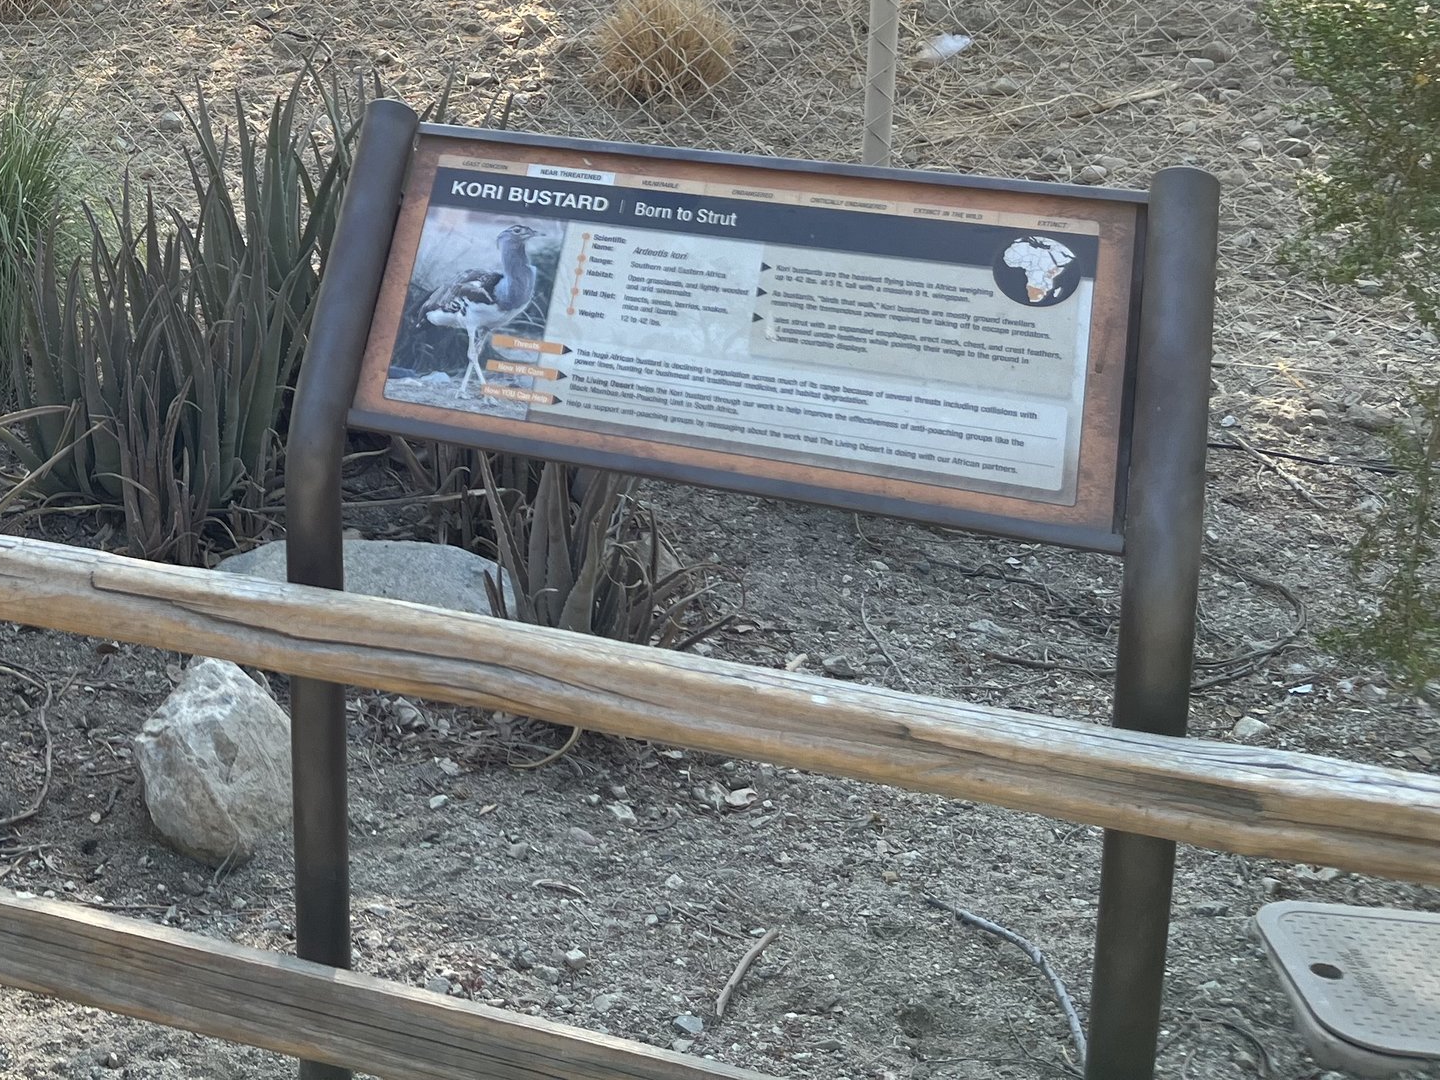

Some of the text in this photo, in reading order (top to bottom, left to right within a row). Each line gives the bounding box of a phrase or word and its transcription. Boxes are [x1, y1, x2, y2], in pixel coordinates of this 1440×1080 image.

[539, 168, 602, 180] NEAR THREATENED
[450, 180, 609, 211] KORI BUSTARD
[634, 202, 737, 226] Born to Strut
[913, 207, 940, 215] EXTINCT
[965, 212, 983, 220] WILD
[1037, 219, 1068, 228] EXTINCT
[931, 292, 970, 303] wingspan.
[934, 283, 957, 291] Africa
[958, 286, 994, 297] weighing
[896, 305, 930, 315] bustards
[945, 311, 971, 320] mostly
[972, 315, 1000, 324] ground
[1001, 318, 1036, 328] dwellers
[933, 319, 958, 328] taking
[959, 321, 971, 329] off
[981, 325, 1009, 334] escape
[1010, 328, 1050, 339] predators.
[889, 340, 921, 351] pointing
[922, 344, 940, 353] their
[942, 348, 965, 357] wings
[976, 351, 990, 359] the
[991, 354, 1019, 364] ground
[919, 335, 939, 343] erect
[940, 338, 961, 346] neck,
[962, 340, 987, 350] chest,
[1004, 346, 1025, 354] crest
[1026, 348, 1062, 359] feathers,
